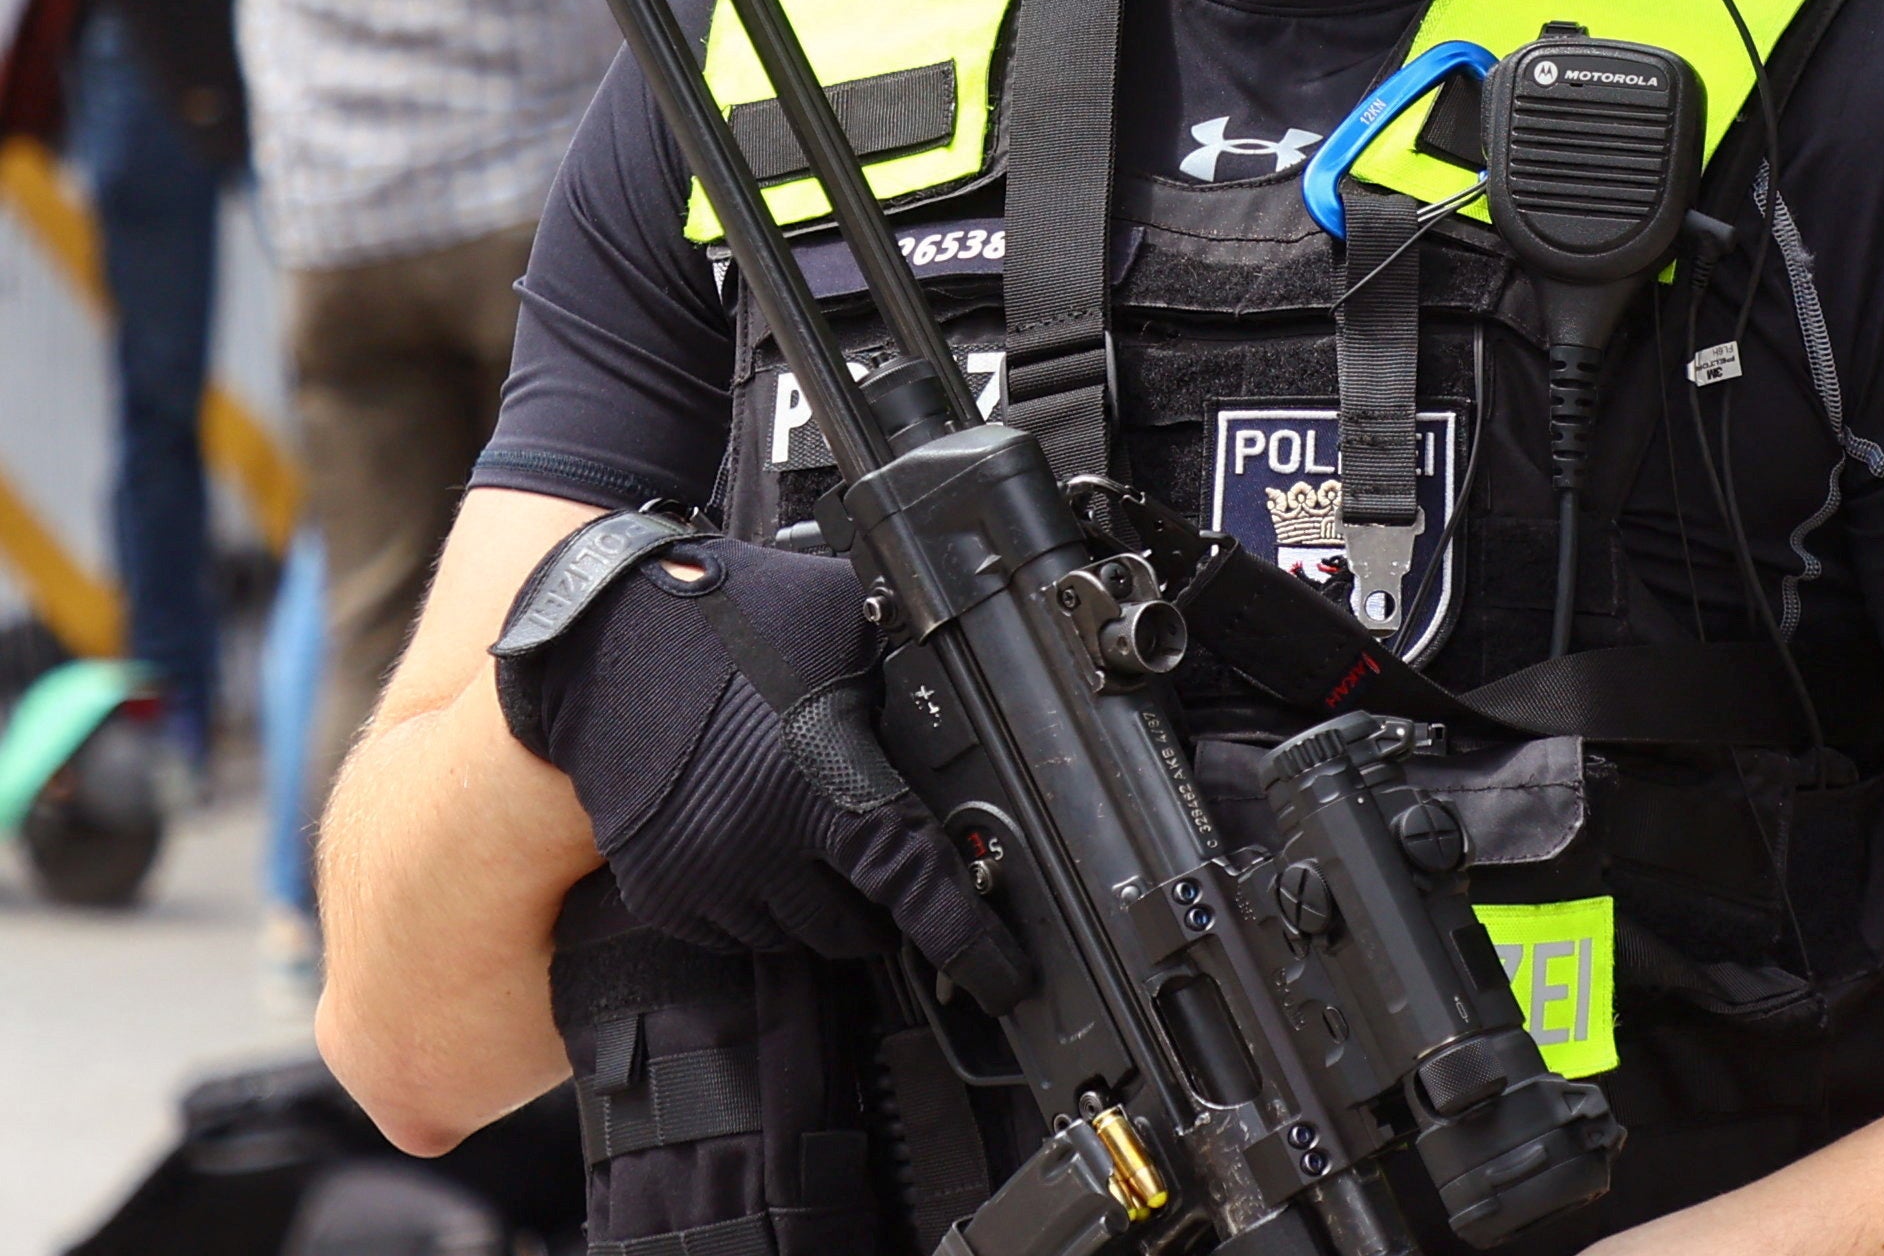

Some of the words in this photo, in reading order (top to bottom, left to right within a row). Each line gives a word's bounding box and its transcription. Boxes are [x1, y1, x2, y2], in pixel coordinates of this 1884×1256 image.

[1564, 69, 1658, 87] MOTOROLA
[1360, 97, 1387, 125] 12KN
[1706, 366, 1723, 380] 3M
[1235, 429, 1435, 476] POLI
[528, 521, 648, 627] POLIZEI
[988, 837, 1004, 861] S
